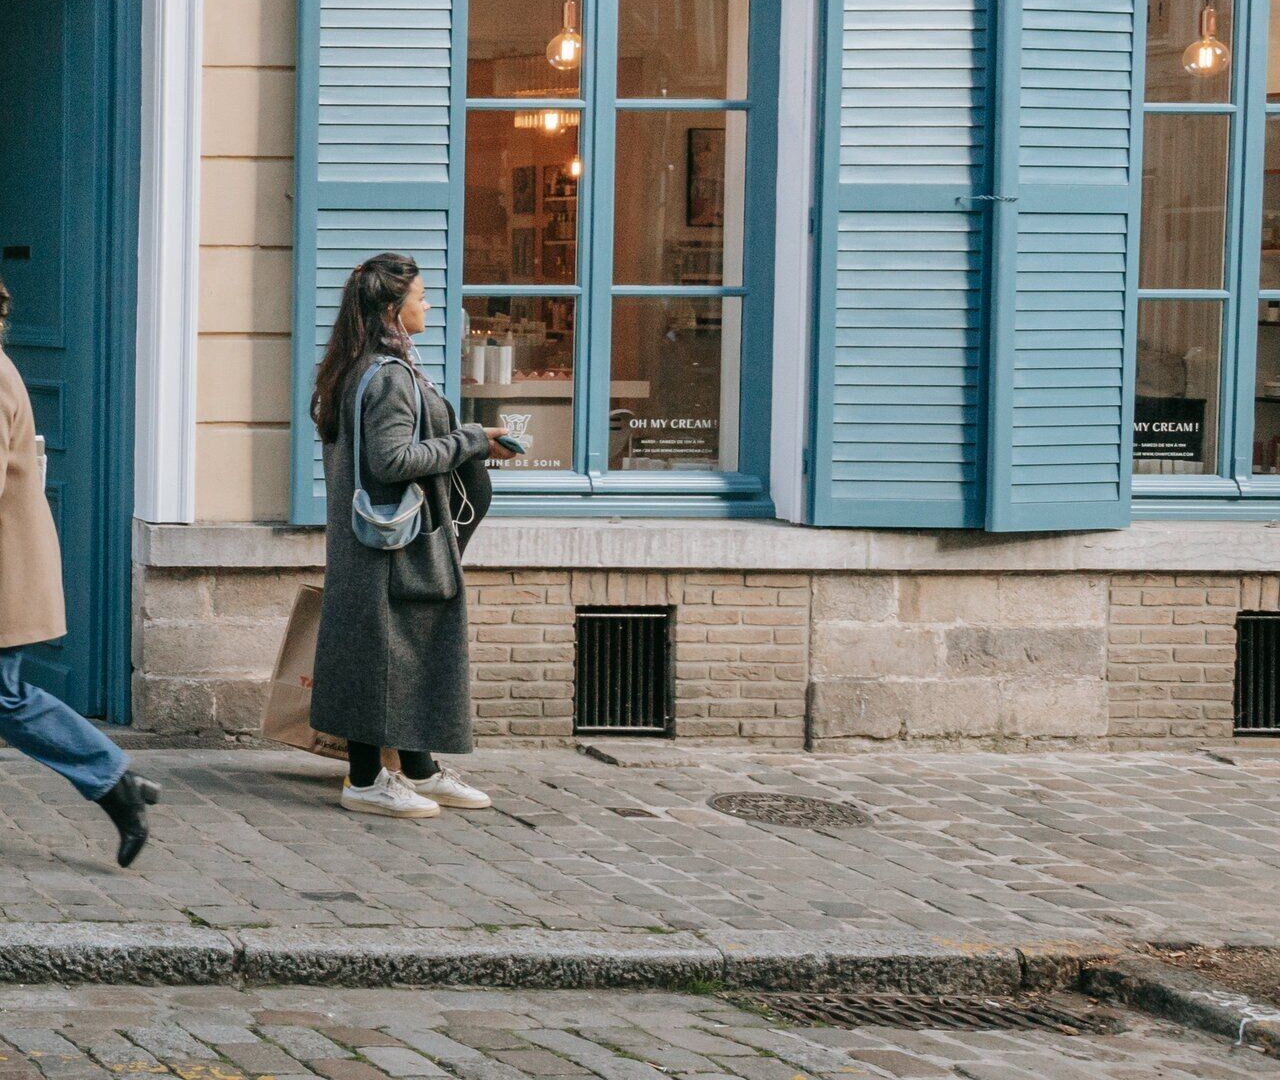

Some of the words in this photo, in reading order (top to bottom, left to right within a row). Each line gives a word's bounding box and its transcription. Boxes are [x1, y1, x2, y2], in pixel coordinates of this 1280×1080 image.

[629, 419, 647, 429] OH
[650, 419, 667, 429] MY
[670, 419, 711, 429] CREAM
[1133, 422, 1150, 432] MY
[1152, 422, 1193, 432] CREAM
